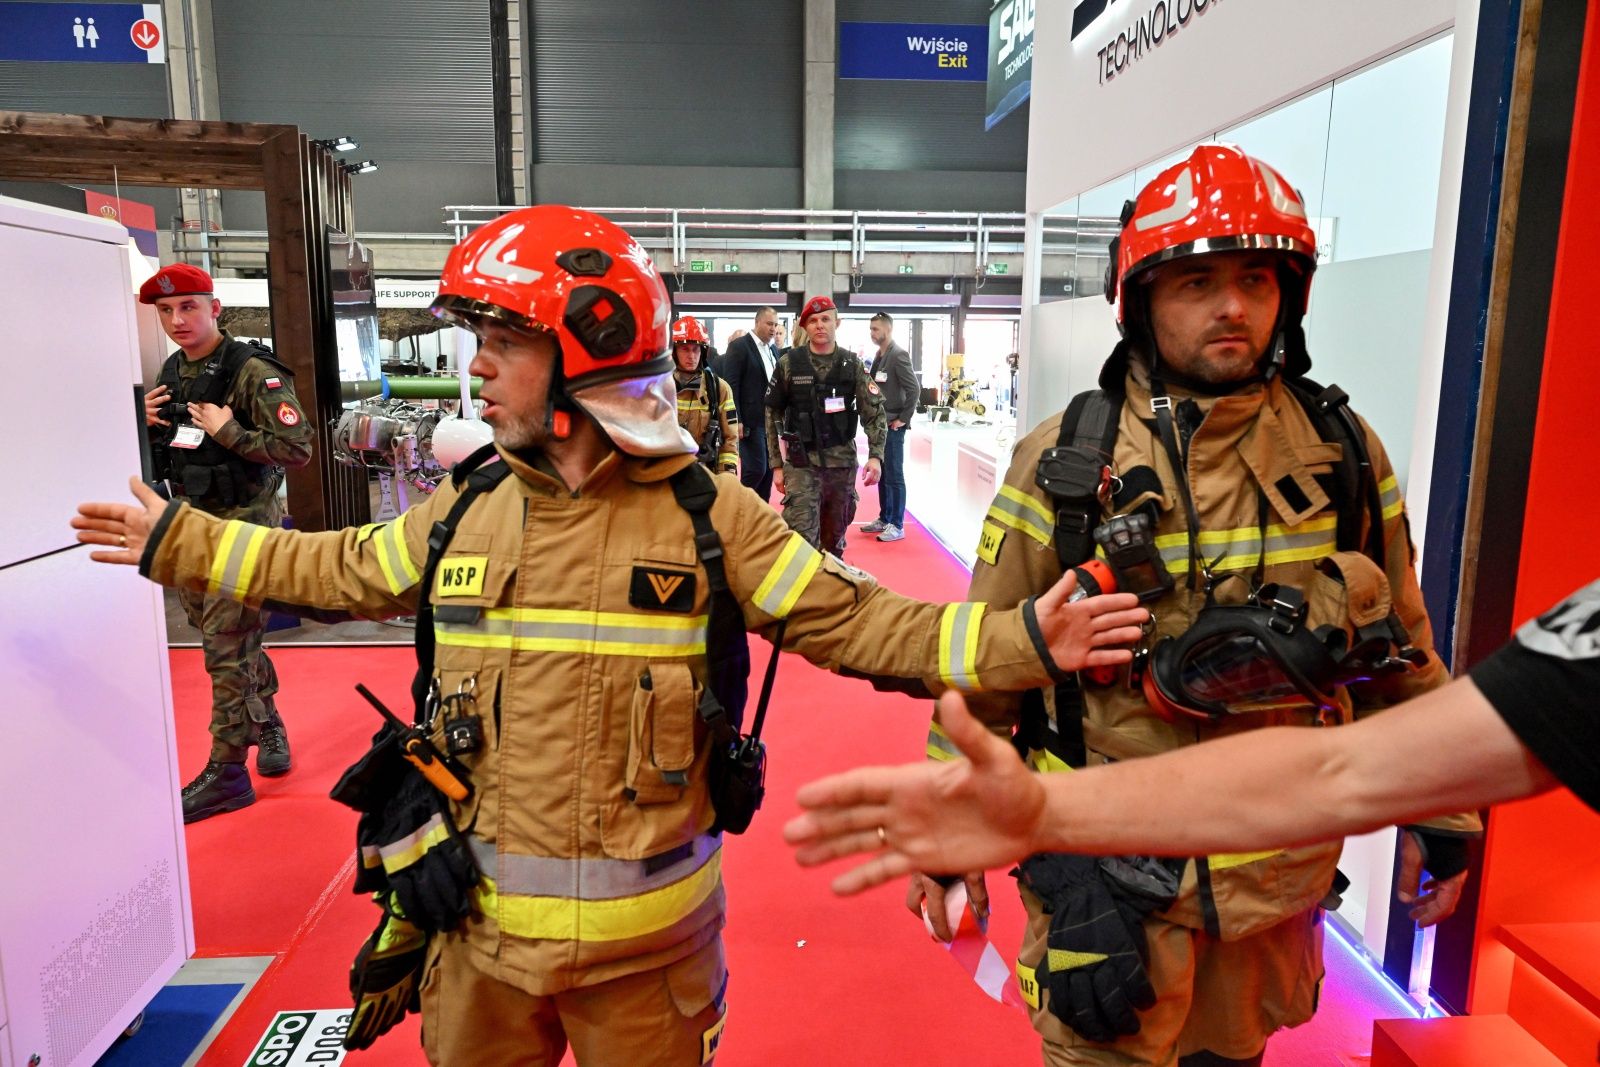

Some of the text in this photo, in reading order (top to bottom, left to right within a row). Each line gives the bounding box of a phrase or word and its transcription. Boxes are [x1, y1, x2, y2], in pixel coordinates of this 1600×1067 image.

[907, 36, 968, 54] Wyjście
[938, 53, 968, 68] Exit
[393, 290, 436, 298] SUPPORT
[442, 566, 477, 587] WSP
